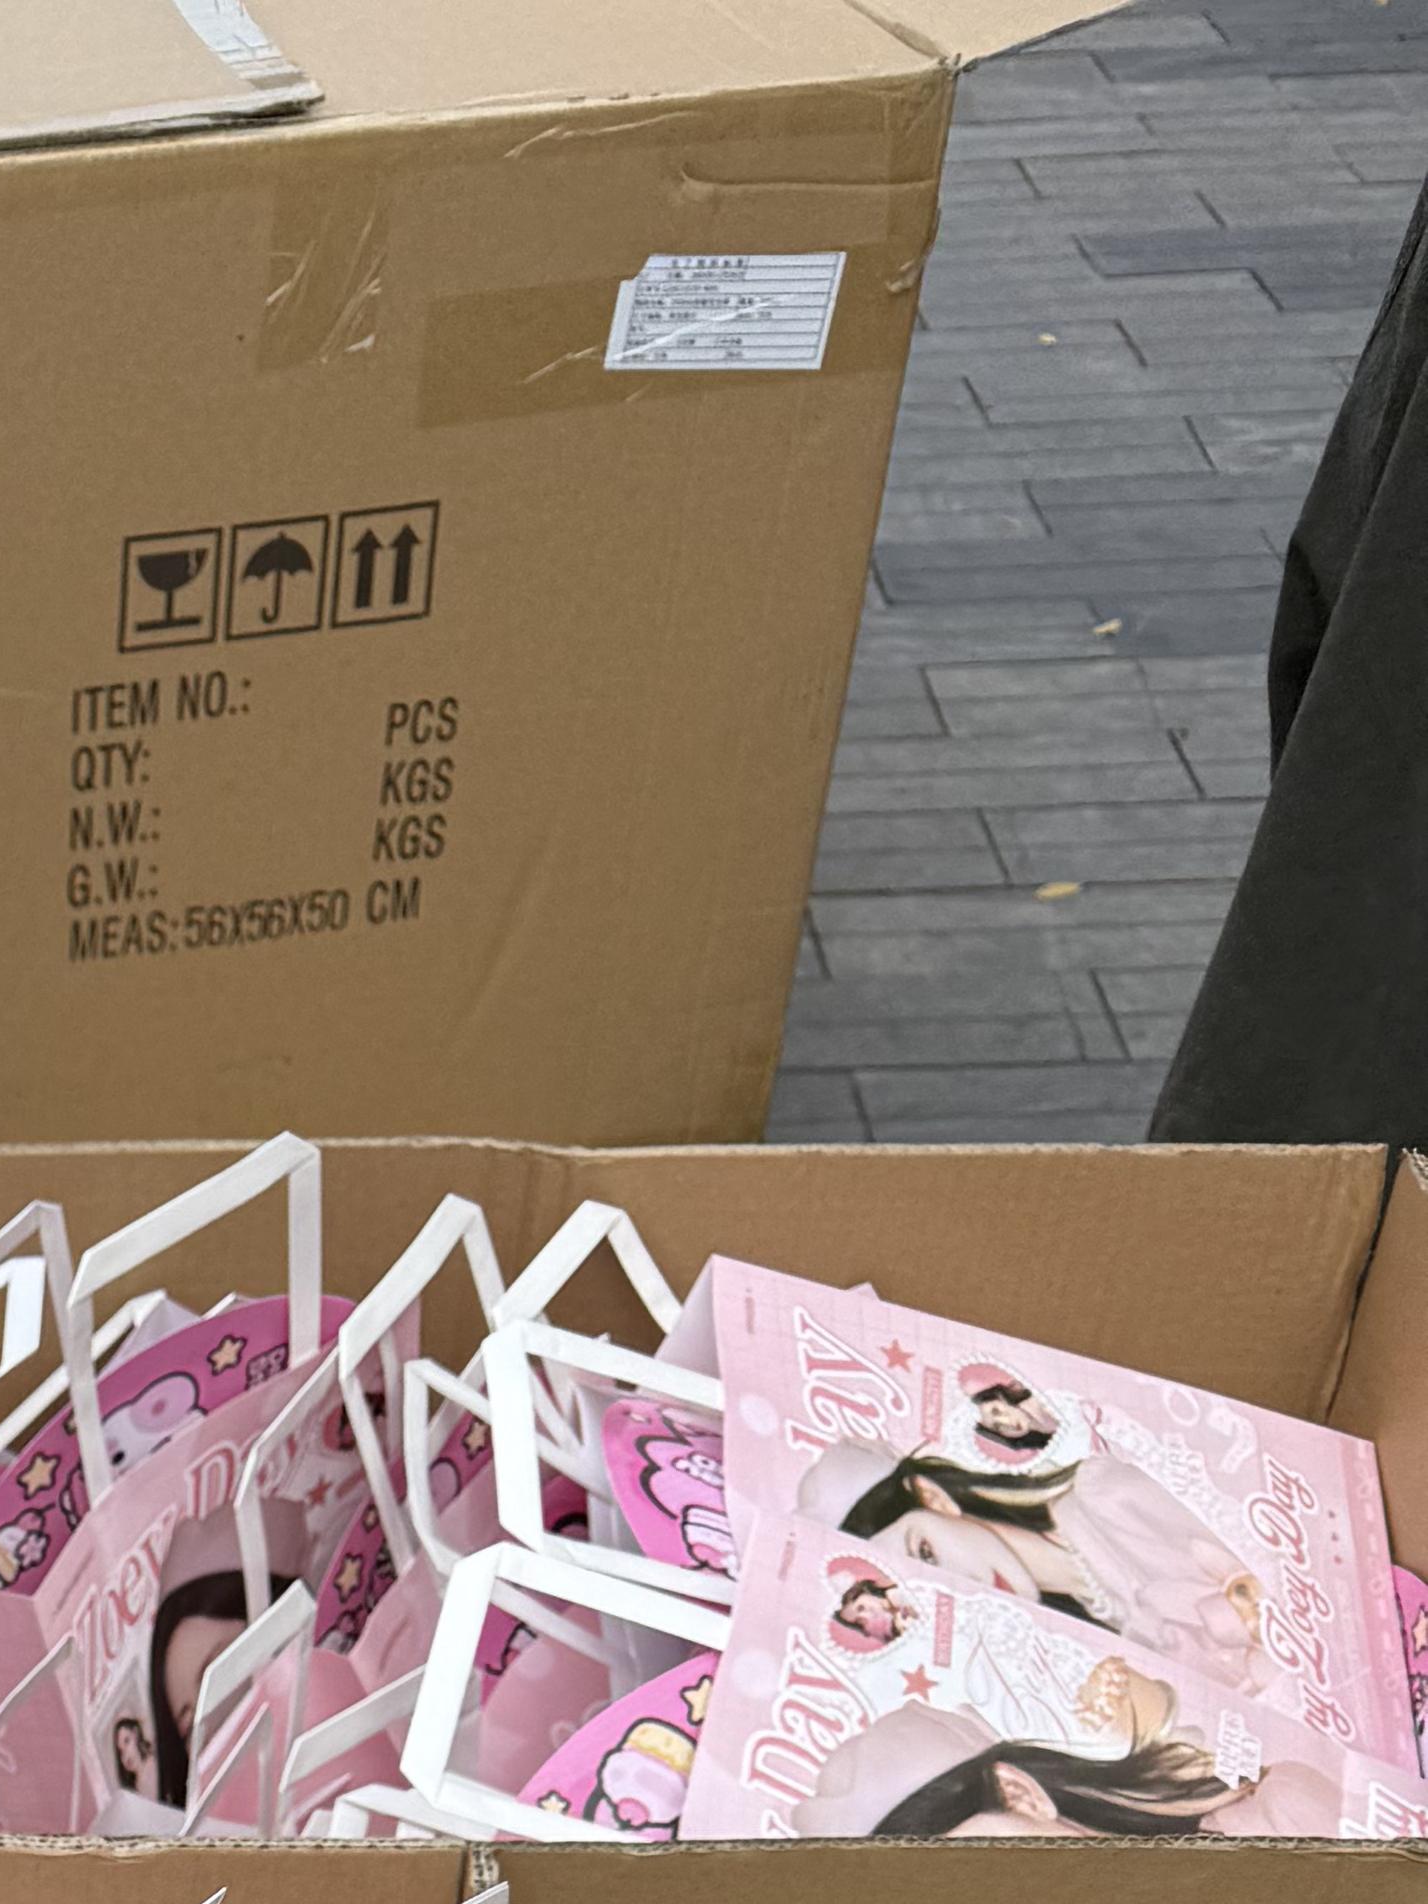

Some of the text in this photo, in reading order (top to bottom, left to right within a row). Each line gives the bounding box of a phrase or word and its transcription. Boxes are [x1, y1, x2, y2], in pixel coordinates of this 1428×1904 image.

[71, 678, 160, 736] ITEM
[385, 696, 459, 748] PCS
[71, 740, 151, 792] QTY:
[379, 756, 454, 808] KGS
[69, 800, 161, 851] N.W.:
[372, 813, 447, 864] KGS
[66, 857, 159, 908] G.W.:
[365, 877, 421, 926] CM
[1245, 1452, 1322, 1566] Day
[1258, 1564, 1336, 1688] Zoey
[741, 1625, 878, 1807] Day
